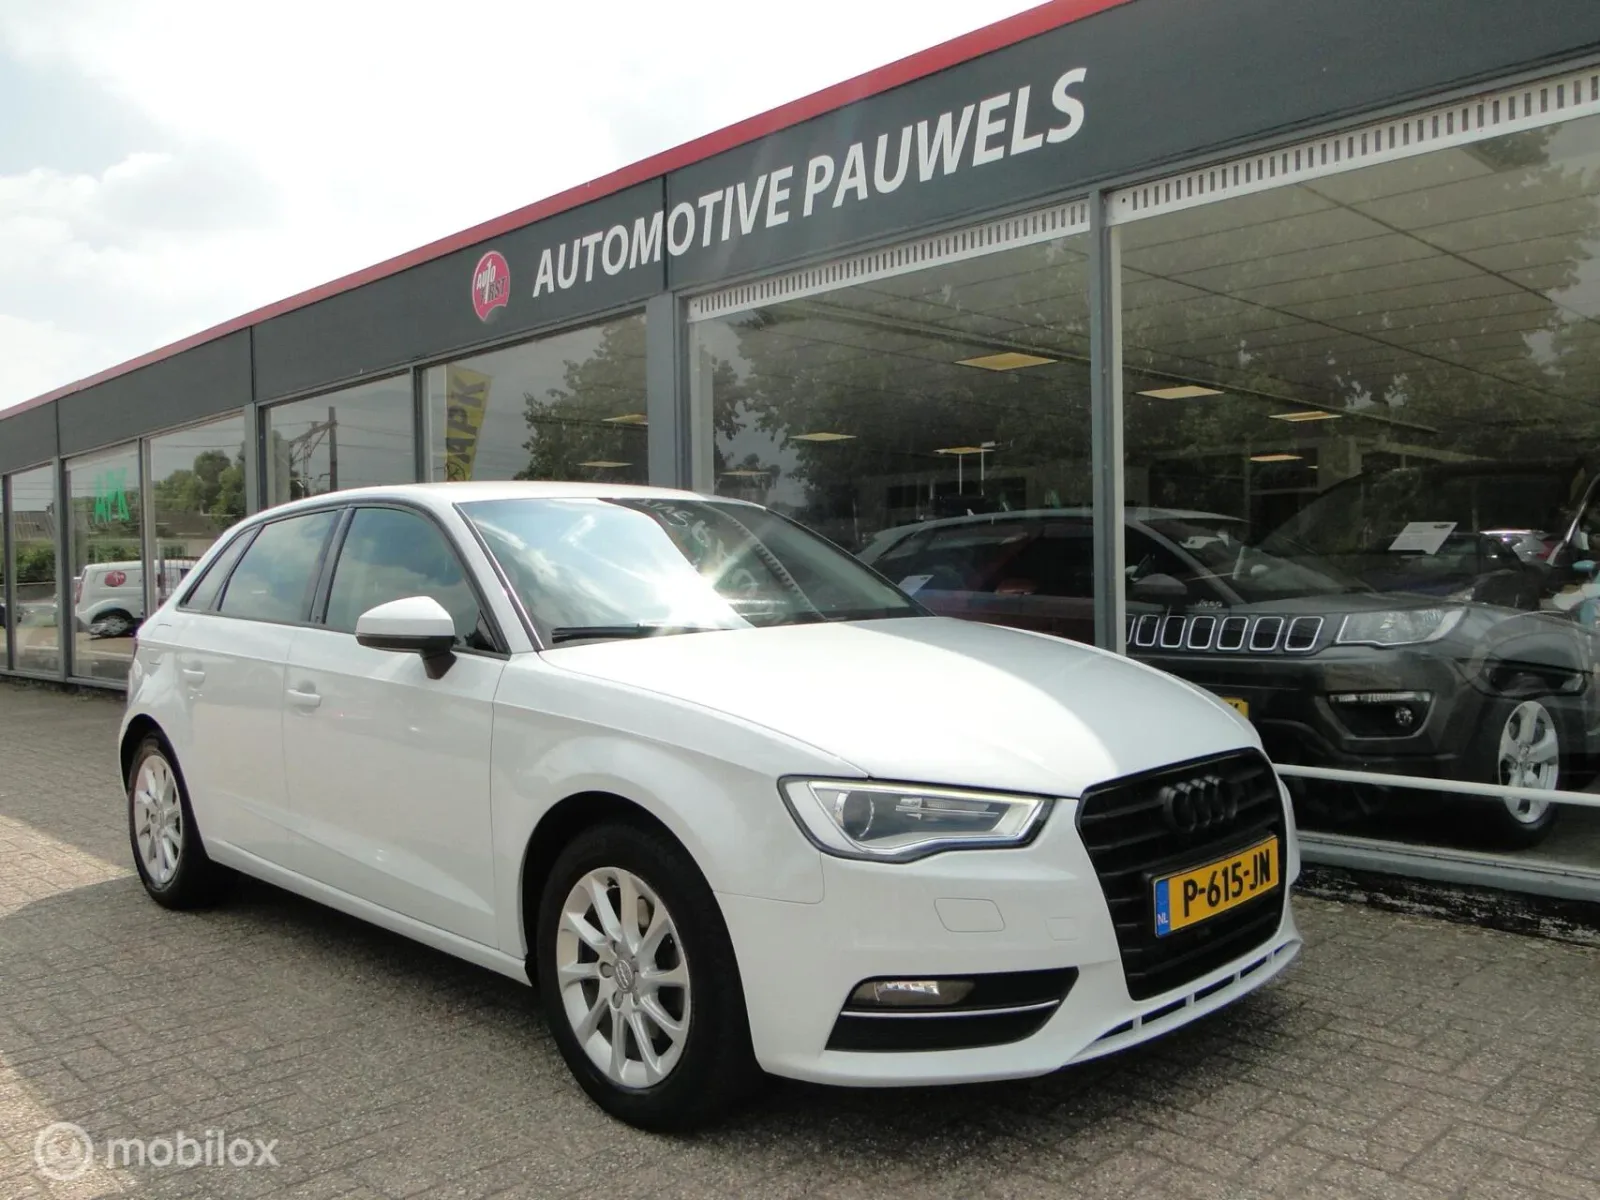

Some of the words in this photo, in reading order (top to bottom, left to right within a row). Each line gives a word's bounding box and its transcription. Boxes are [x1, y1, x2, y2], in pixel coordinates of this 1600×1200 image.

[533, 166, 793, 298] AUTOMOTIVE
[803, 67, 1087, 217] PAUWELS
[446, 376, 487, 465] APK
[1157, 911, 1169, 926] NL
[1183, 848, 1271, 918] P-615-JN
